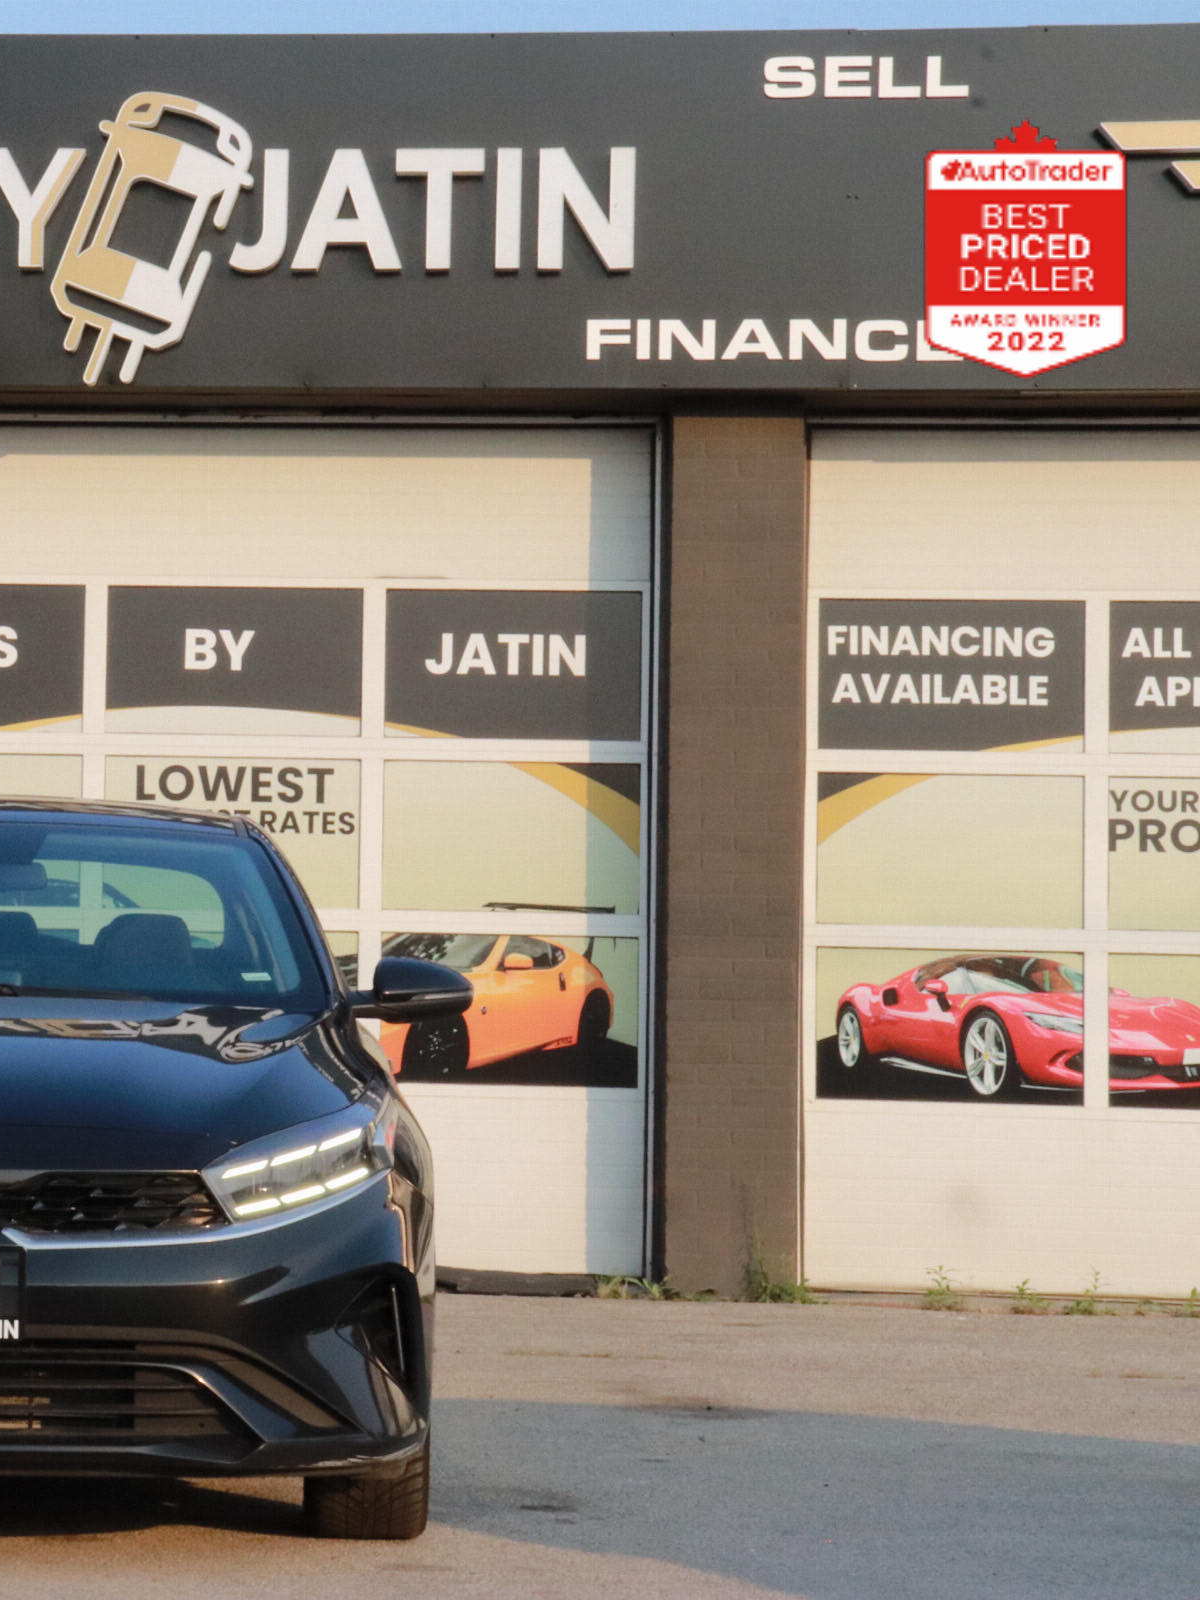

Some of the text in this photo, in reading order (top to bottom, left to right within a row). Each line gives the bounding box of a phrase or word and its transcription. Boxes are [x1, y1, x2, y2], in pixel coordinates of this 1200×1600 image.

[762, 55, 971, 100] SELL
[228, 146, 636, 274] JATIN
[182, 628, 256, 672] BY
[424, 632, 588, 677] JATIN
[827, 625, 1055, 658] FINANCING
[1121, 627, 1192, 658] ALL
[832, 673, 1049, 706] AVAILABLE
[136, 765, 335, 804] LOWEST
[1108, 789, 1199, 813] YOUR
[259, 810, 355, 835] RATES
